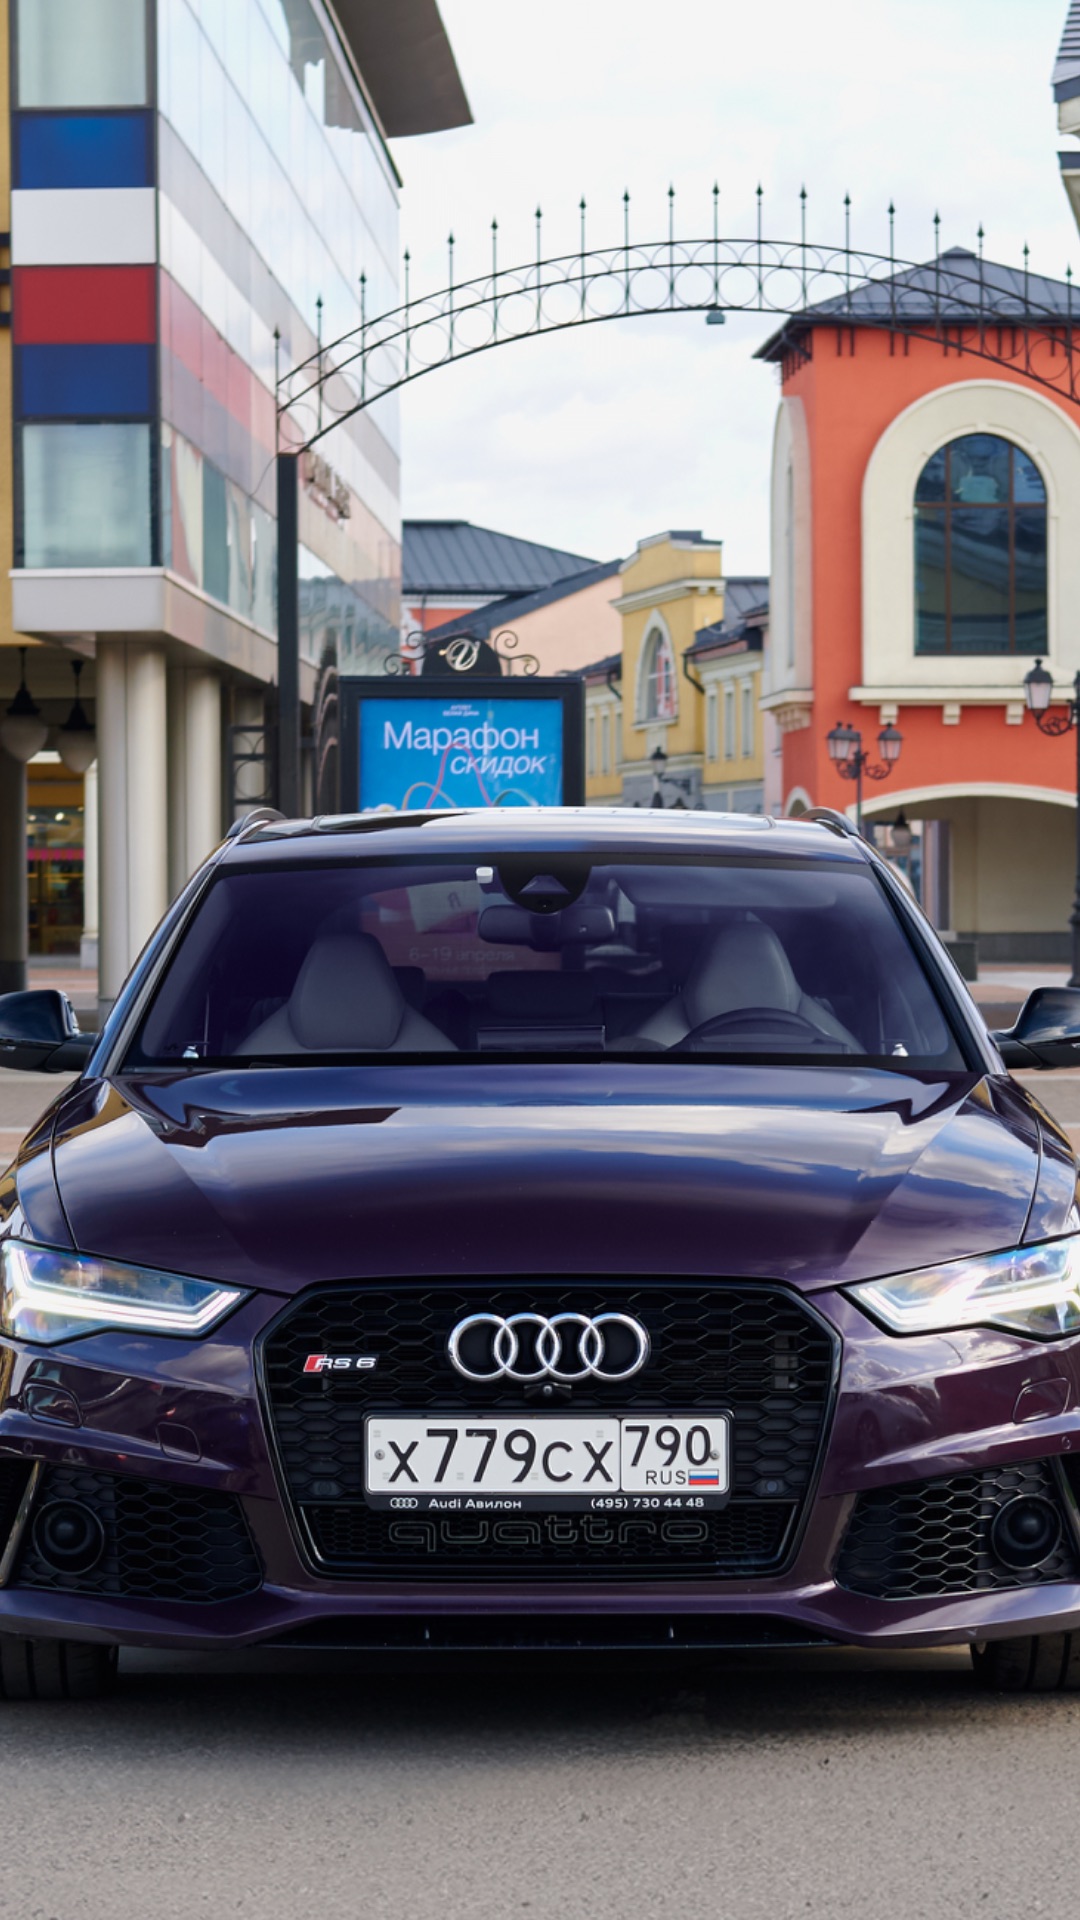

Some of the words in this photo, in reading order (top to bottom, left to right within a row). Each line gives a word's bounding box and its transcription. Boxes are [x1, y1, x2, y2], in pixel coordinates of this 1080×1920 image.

[384, 721, 539, 756] Марафон
[450, 755, 547, 778] скидок
[356, 1357, 376, 1369] 6
[625, 1425, 711, 1467] 790
[646, 1470, 686, 1485] RUS
[428, 1498, 461, 1509] Audi
[465, 1499, 522, 1509] Авилон
[590, 1498, 629, 1509] (495)
[632, 1498, 657, 1508] 730
[663, 1498, 682, 1508] 44
[685, 1498, 705, 1508] 48
[388, 1515, 708, 1552] quattro
